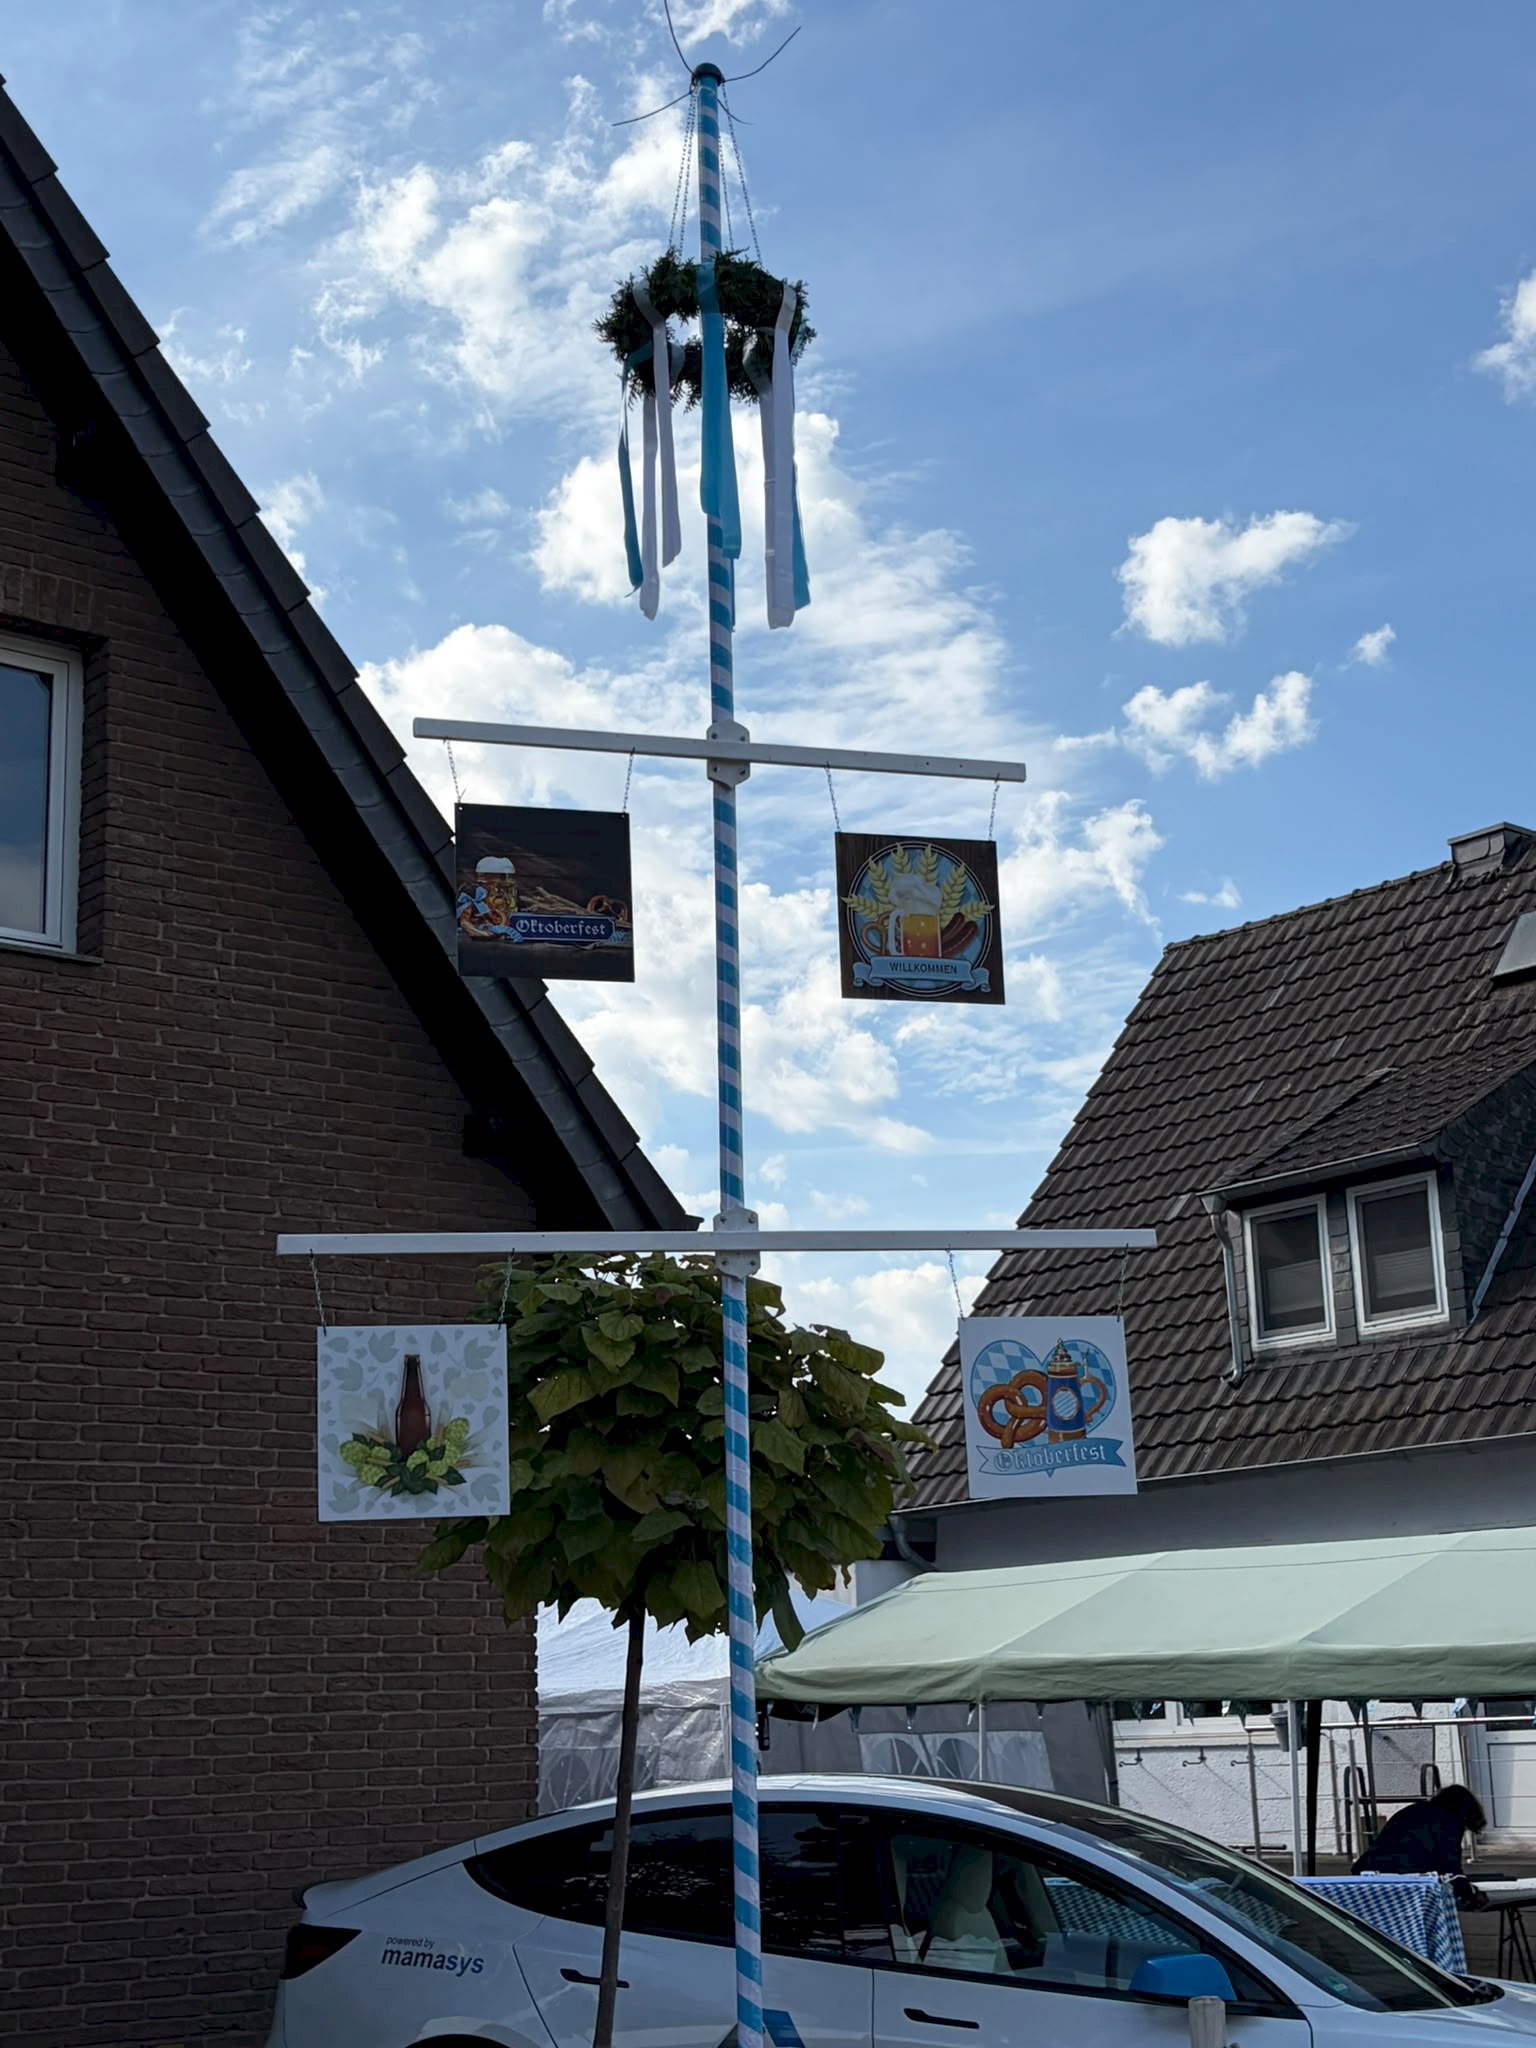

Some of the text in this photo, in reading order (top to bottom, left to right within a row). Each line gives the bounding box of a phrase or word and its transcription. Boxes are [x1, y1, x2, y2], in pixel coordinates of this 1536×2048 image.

[515, 919, 606, 935] Oktoberfest
[889, 962, 957, 974] WILLKOMMEN
[993, 1443, 1106, 1471] Oktoberfest
[386, 1936, 435, 1949] powered by
[381, 1948, 485, 1977] mamasys
